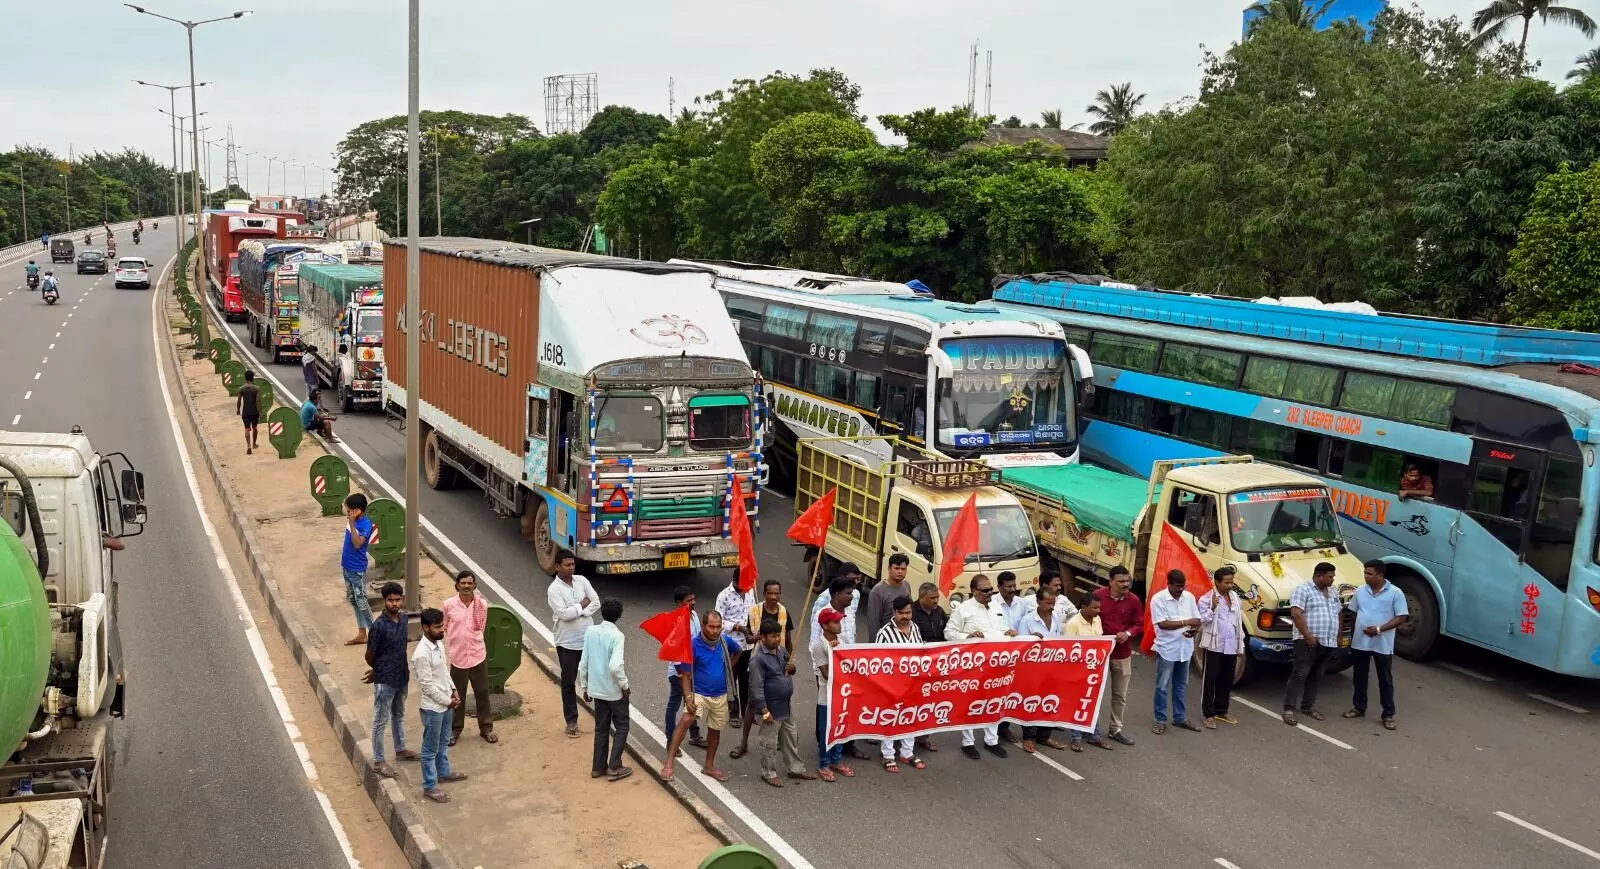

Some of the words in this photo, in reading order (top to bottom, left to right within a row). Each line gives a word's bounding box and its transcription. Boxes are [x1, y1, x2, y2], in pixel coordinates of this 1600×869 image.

[776, 393, 861, 443] MAHAVEER
[1286, 406, 1301, 423] 2X2
[1302, 408, 1334, 430] SLEEPER
[1335, 415, 1363, 436] COACH
[689, 558, 718, 569] LUCK
[840, 657, 894, 675] ଭାରତର
